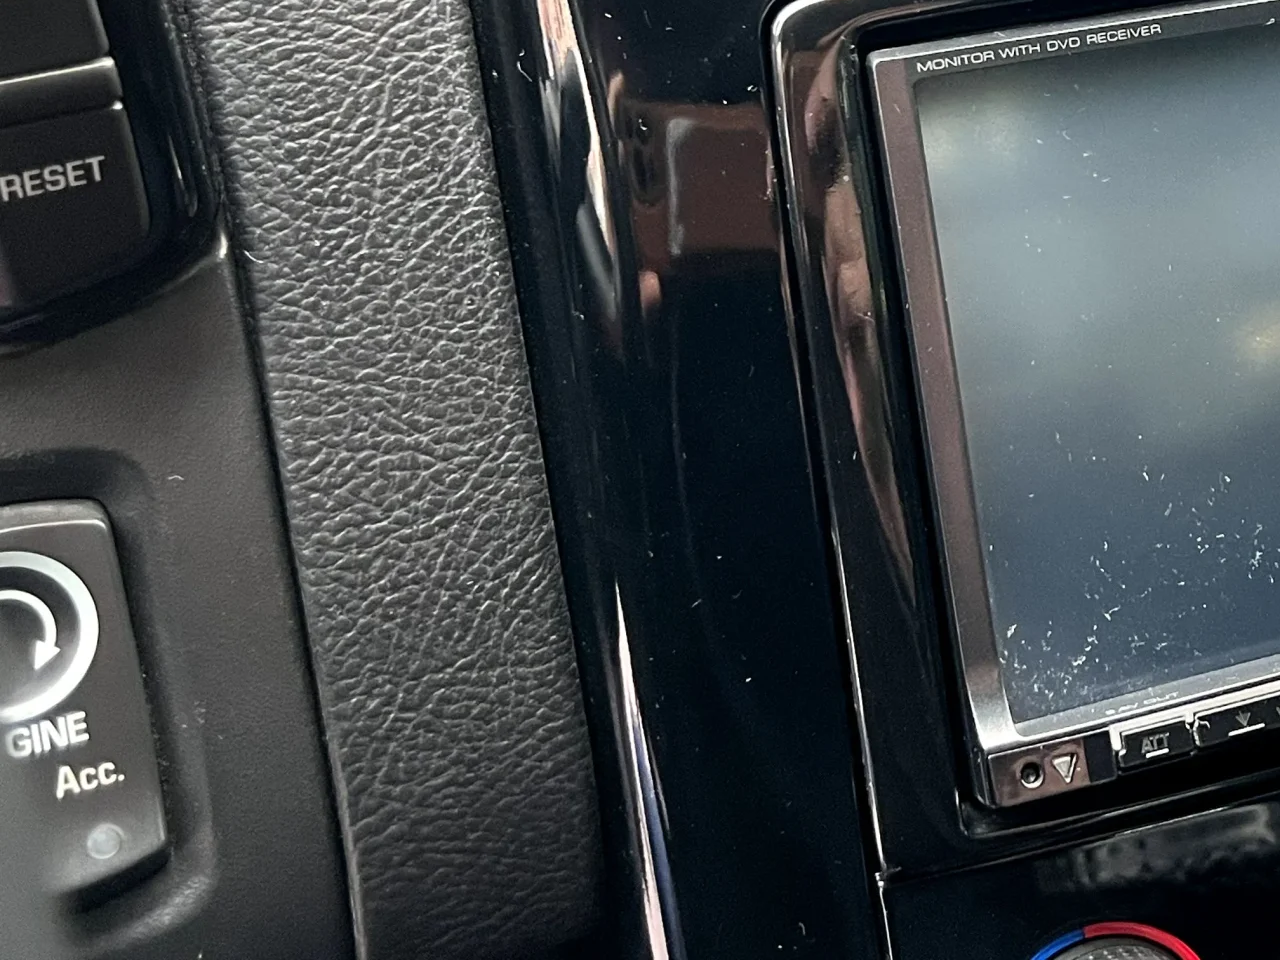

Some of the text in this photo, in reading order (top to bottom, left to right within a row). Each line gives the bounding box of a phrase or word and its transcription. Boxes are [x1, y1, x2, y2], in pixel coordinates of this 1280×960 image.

[917, 24, 1162, 73] MONITOR WITH DVD RECEIVER
[0, 155, 105, 203] RESET
[6, 711, 90, 759] GINE
[1141, 732, 1170, 754] ATT
[56, 760, 125, 799] Acc.
